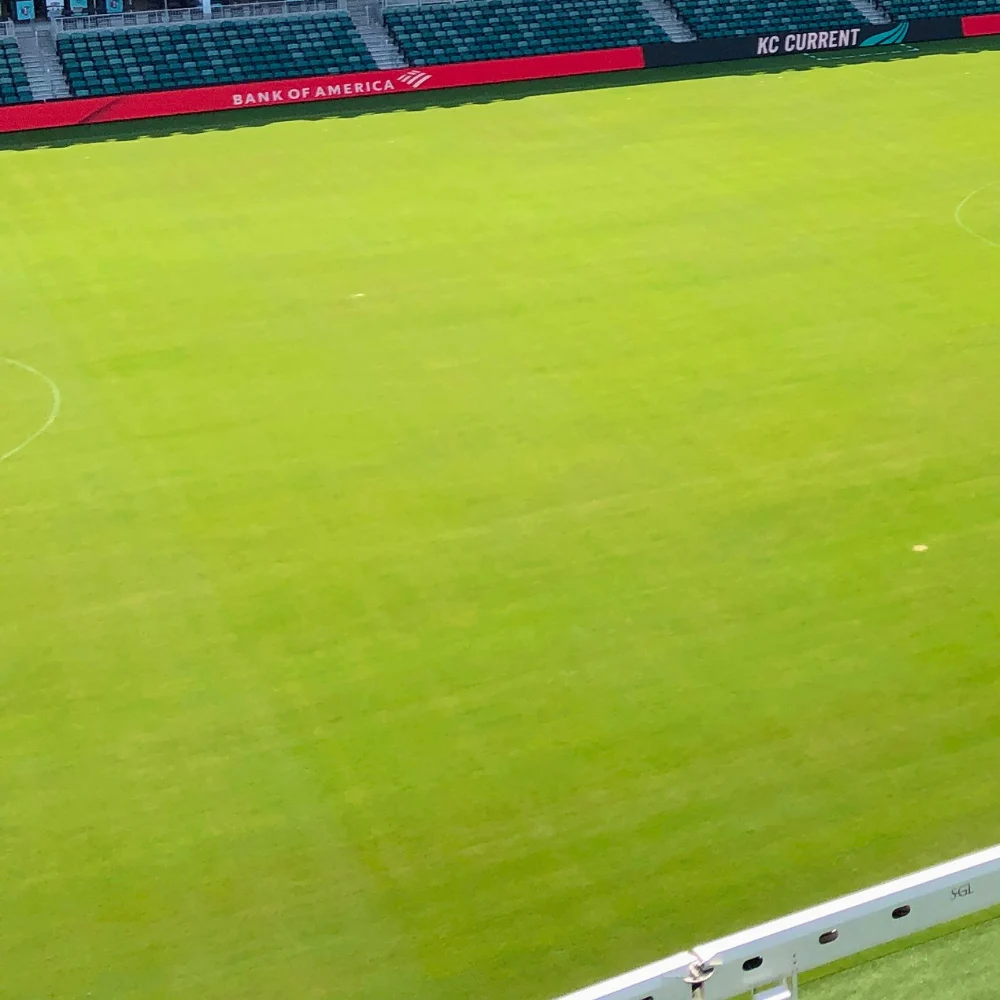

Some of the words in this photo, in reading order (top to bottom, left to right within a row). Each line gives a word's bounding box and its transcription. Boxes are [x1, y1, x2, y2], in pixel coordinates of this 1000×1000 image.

[757, 35, 780, 55] KC
[784, 28, 861, 52] CURRENT
[232, 90, 283, 105] BANK
[287, 87, 311, 100] OF
[314, 79, 395, 98] AMERICA
